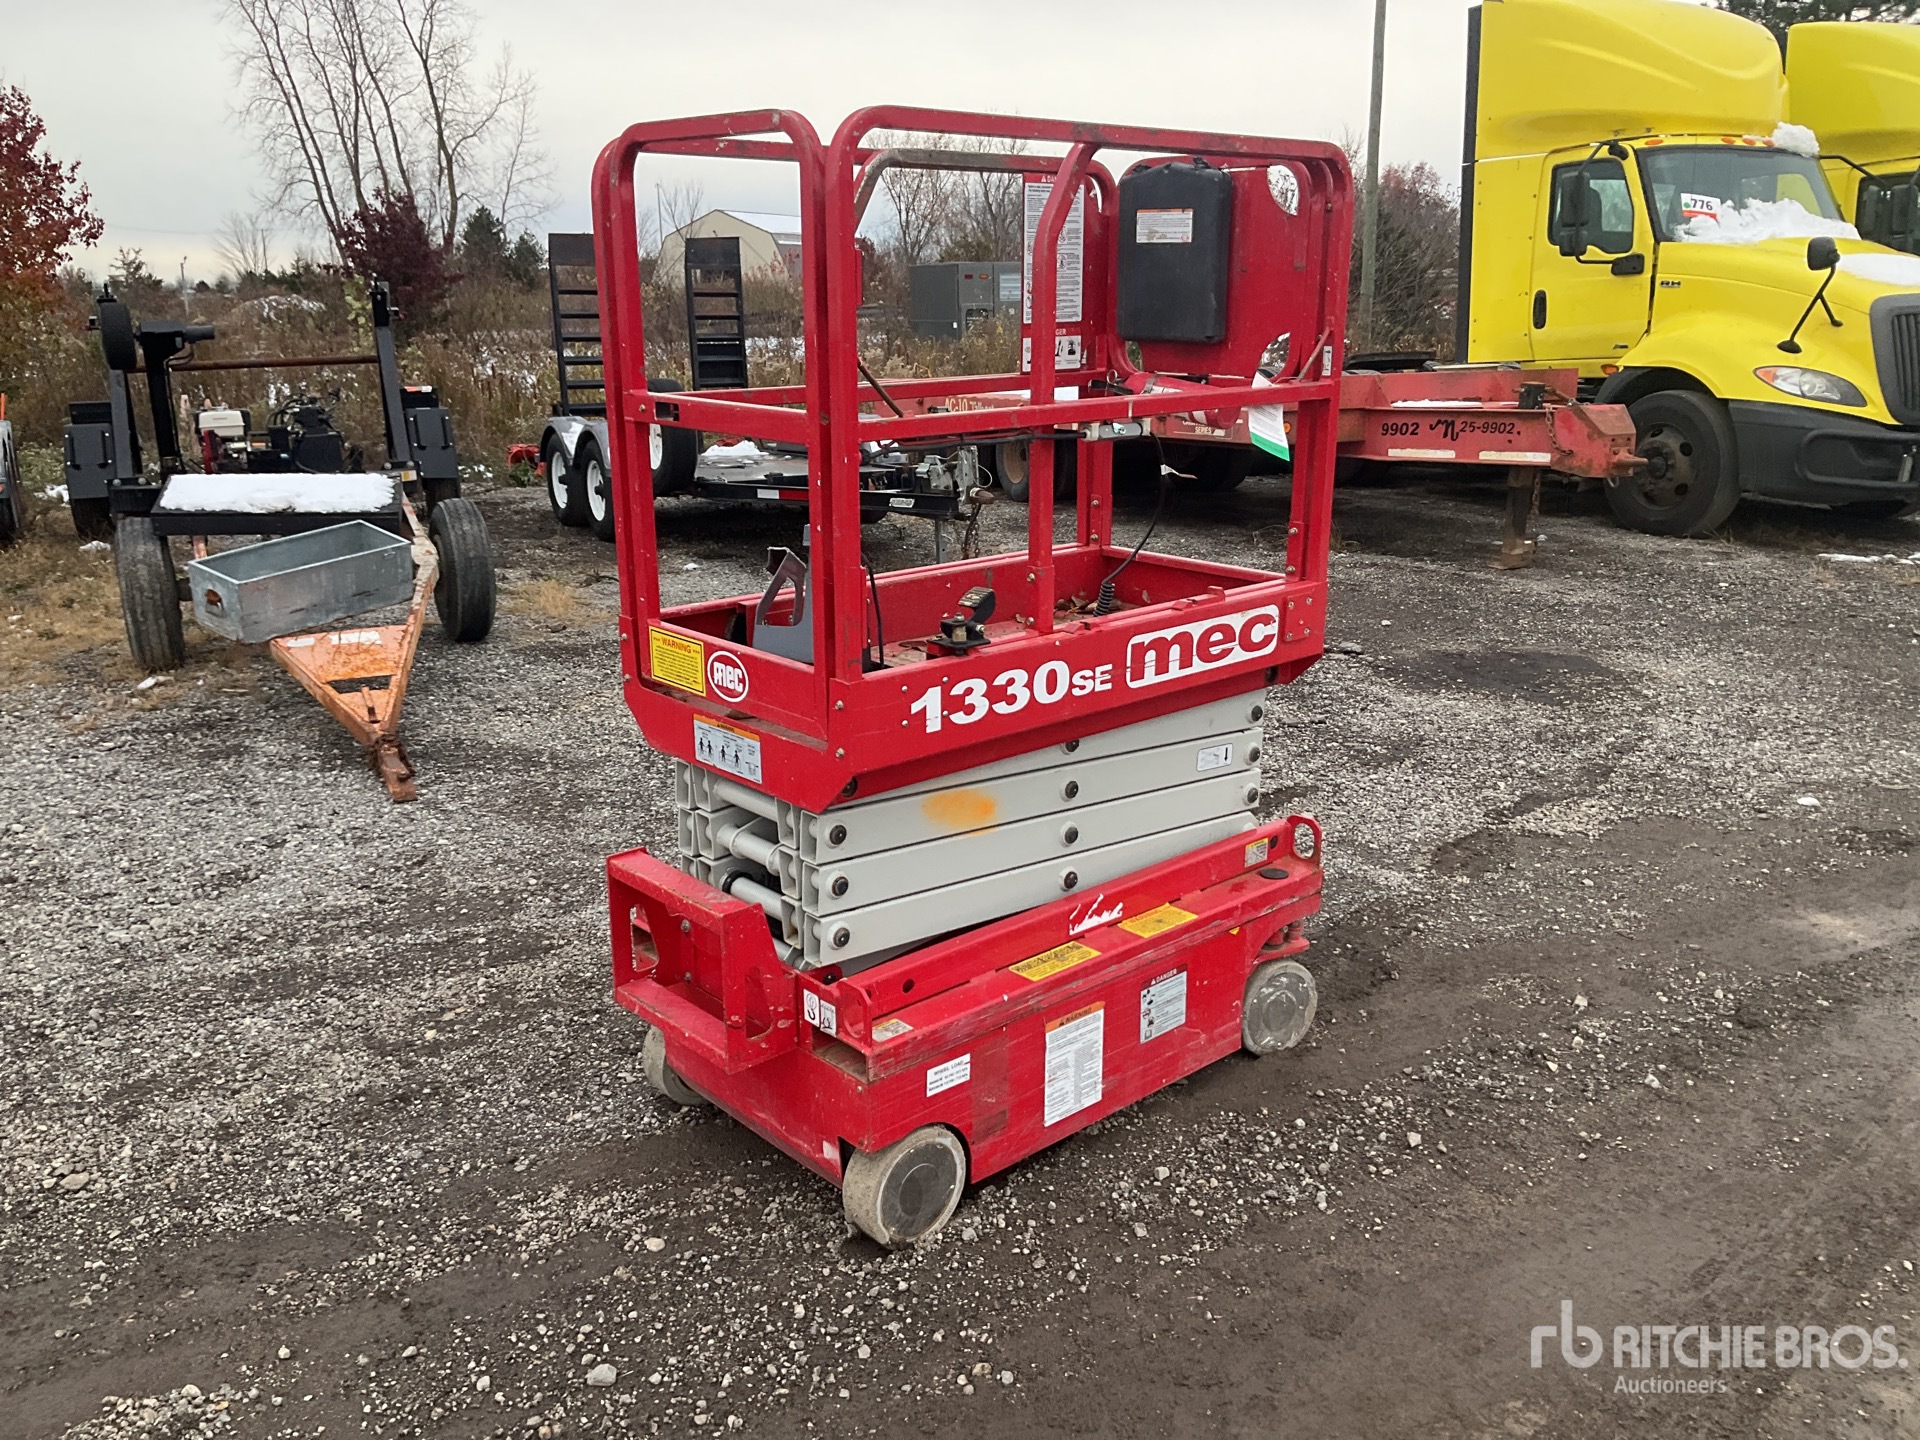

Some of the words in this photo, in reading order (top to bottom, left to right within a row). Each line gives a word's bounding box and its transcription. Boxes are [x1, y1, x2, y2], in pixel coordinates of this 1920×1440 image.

[1691, 198, 1713, 211] 776
[1381, 421, 1420, 437] 9902
[661, 636, 692, 654] WARNING
[1155, 968, 1178, 983] DANGER
[1065, 1006, 1093, 1024] WARNING
